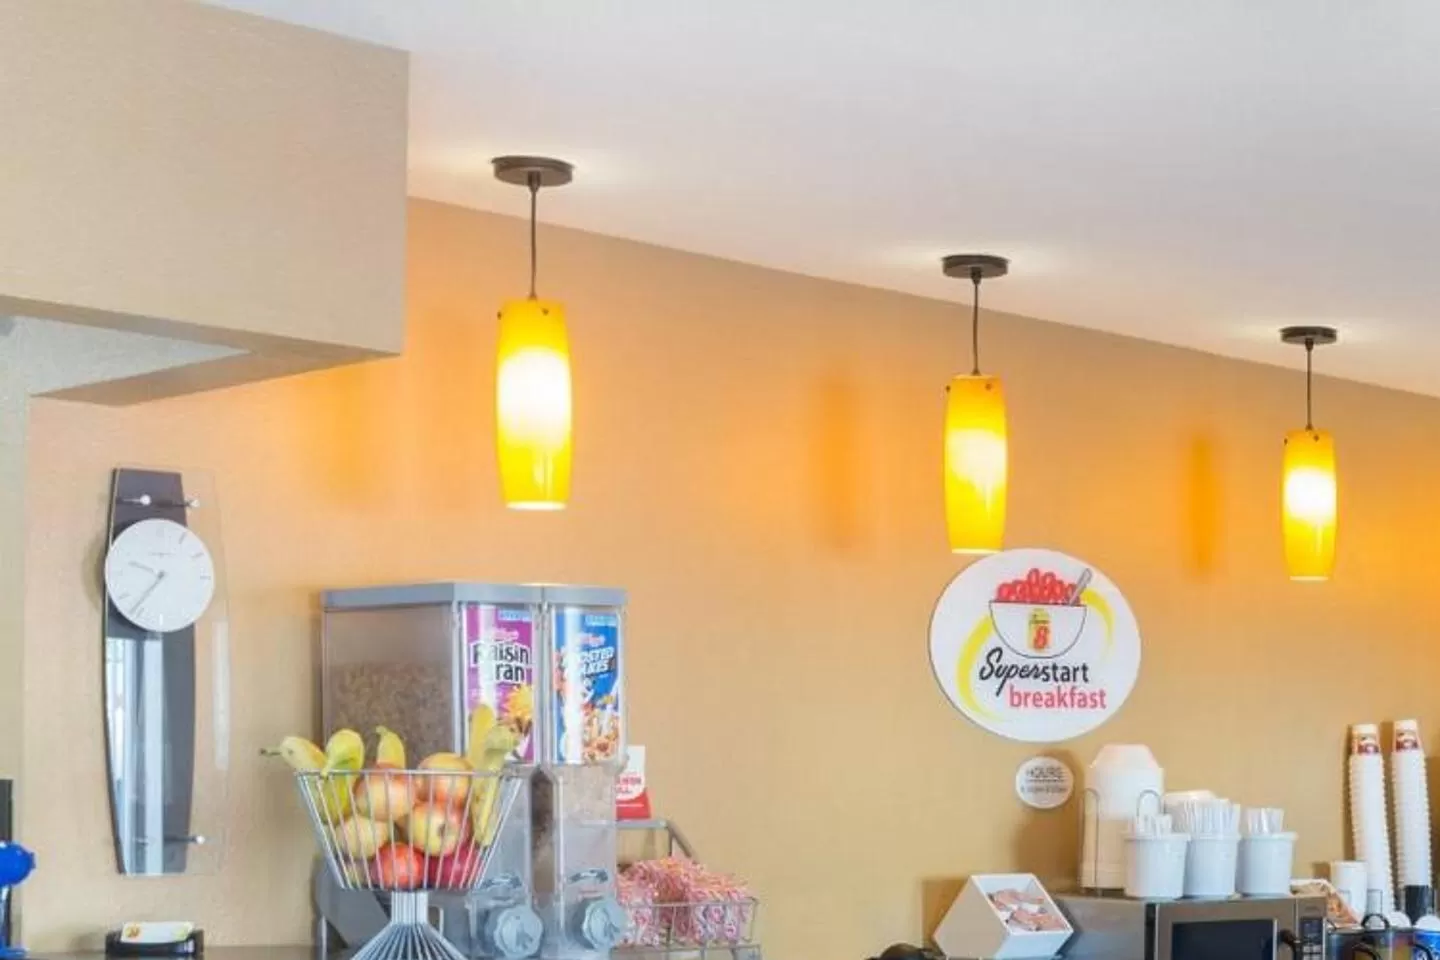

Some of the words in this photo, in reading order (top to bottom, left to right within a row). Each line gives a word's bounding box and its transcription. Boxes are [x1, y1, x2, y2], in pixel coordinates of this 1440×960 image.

[489, 662, 525, 682] ran
[979, 646, 1089, 697] Superstart
[1009, 684, 1106, 709] breakfast
